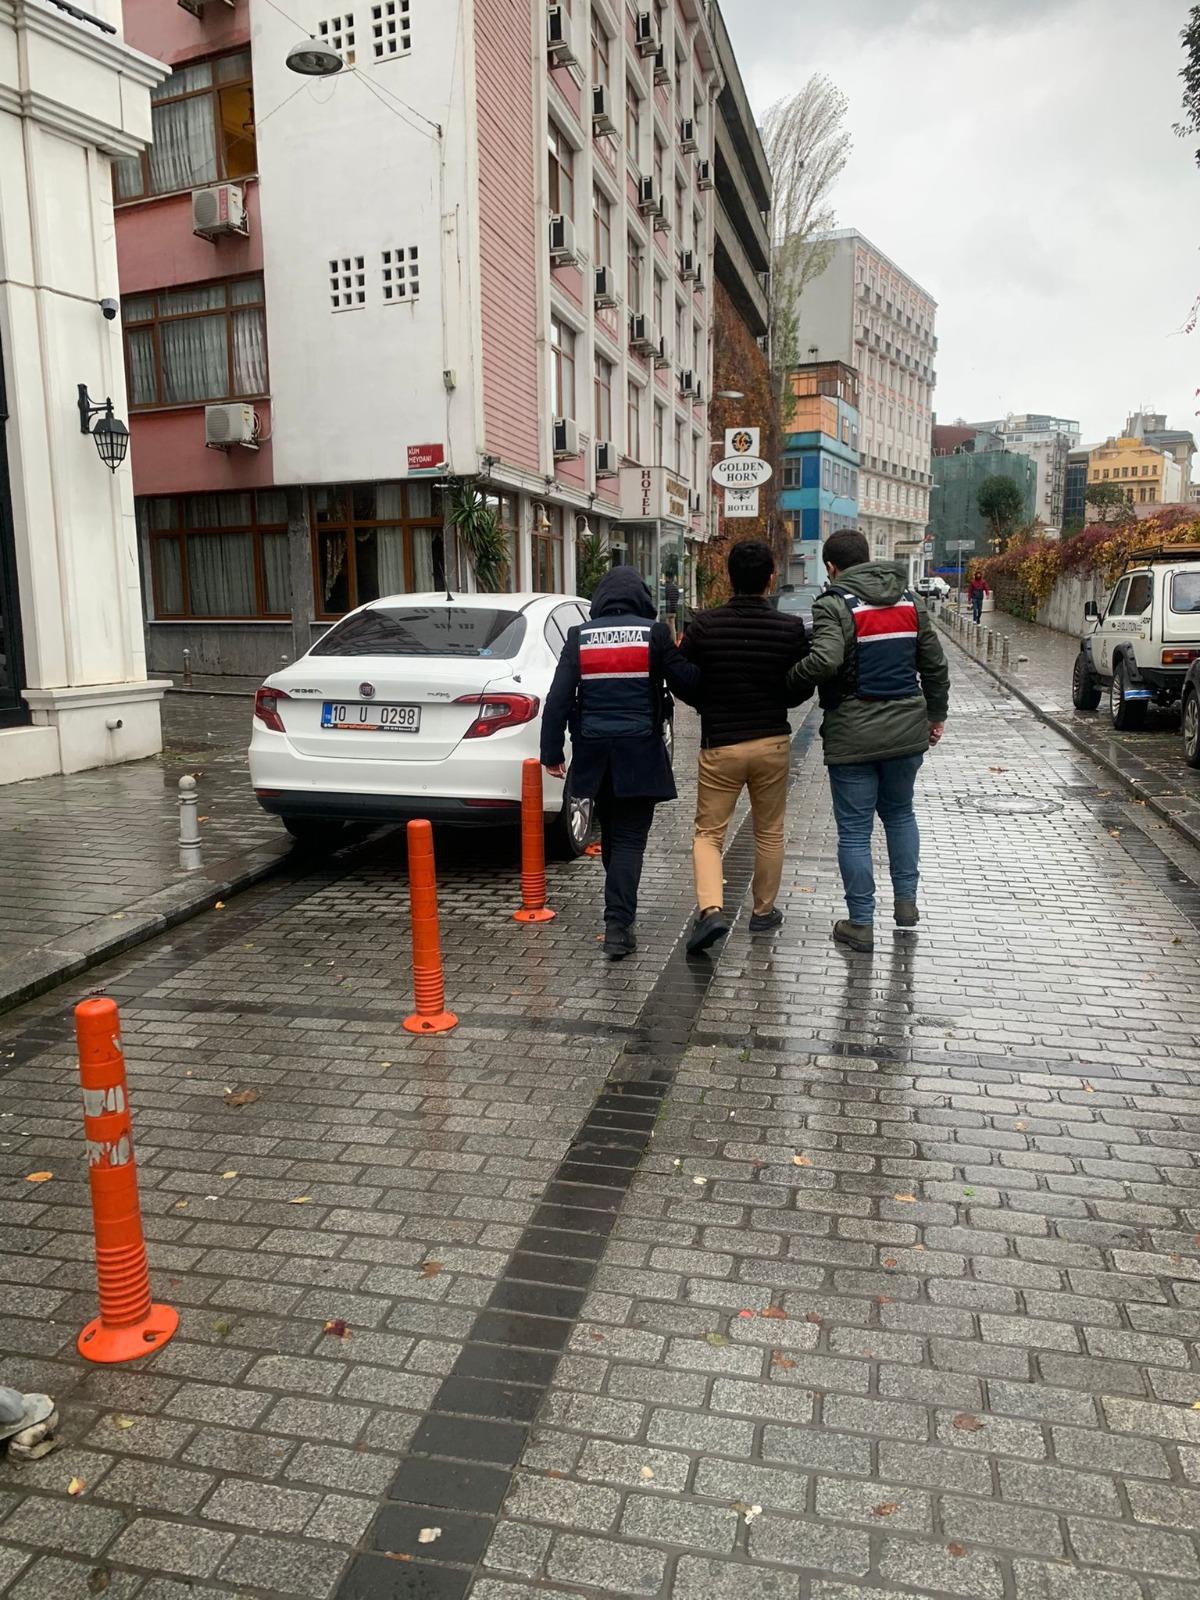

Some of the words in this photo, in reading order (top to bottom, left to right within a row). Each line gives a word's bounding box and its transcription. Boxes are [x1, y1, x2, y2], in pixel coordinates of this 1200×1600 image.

[719, 462, 764, 472] GOLDEN
[726, 472, 758, 482] HORN
[641, 470, 651, 516] HOTEL
[727, 504, 755, 512] HOTEL
[586, 630, 644, 644] JANDARMA
[333, 705, 346, 722] 10
[360, 706, 368, 723] U
[380, 708, 415, 725] 0298
